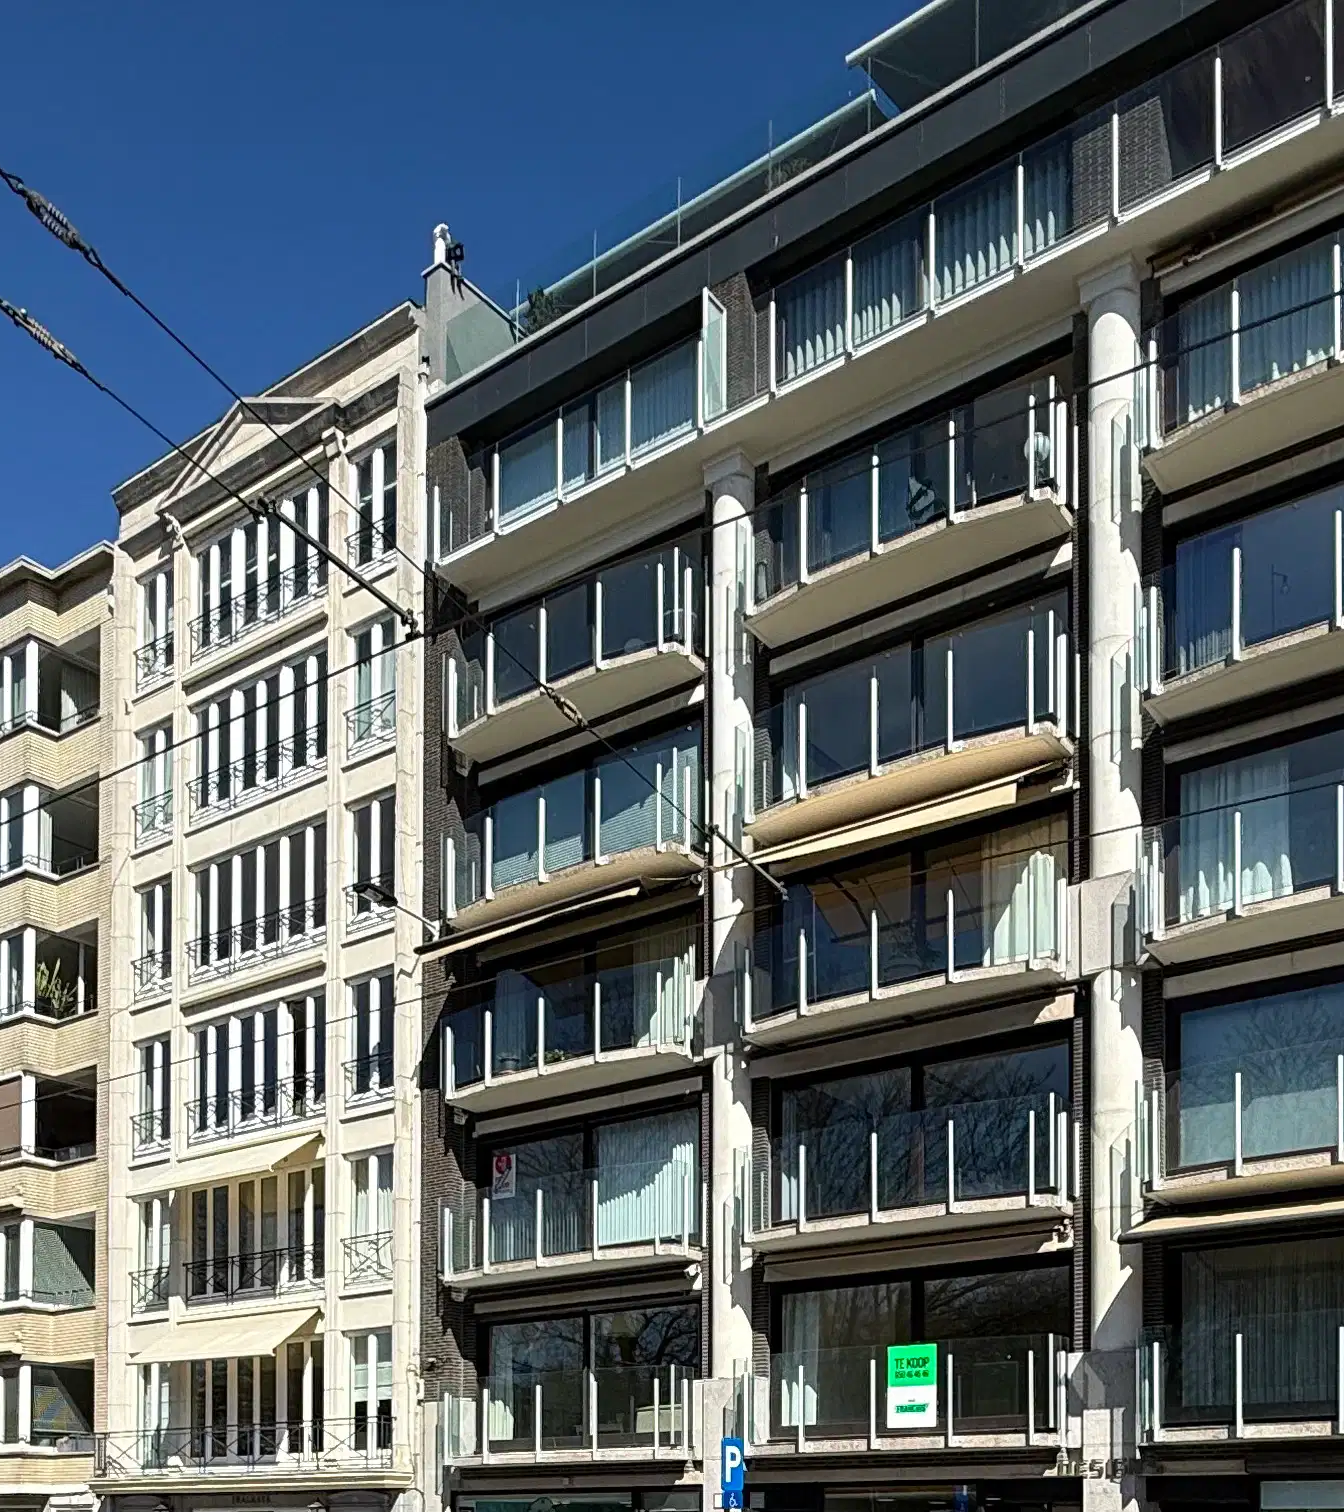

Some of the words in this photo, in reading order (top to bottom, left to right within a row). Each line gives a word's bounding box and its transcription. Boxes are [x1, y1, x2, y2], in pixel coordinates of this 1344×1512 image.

[894, 1357, 905, 1370] TE
[906, 1356, 930, 1369] KOOP
[725, 1445, 742, 1483] P
